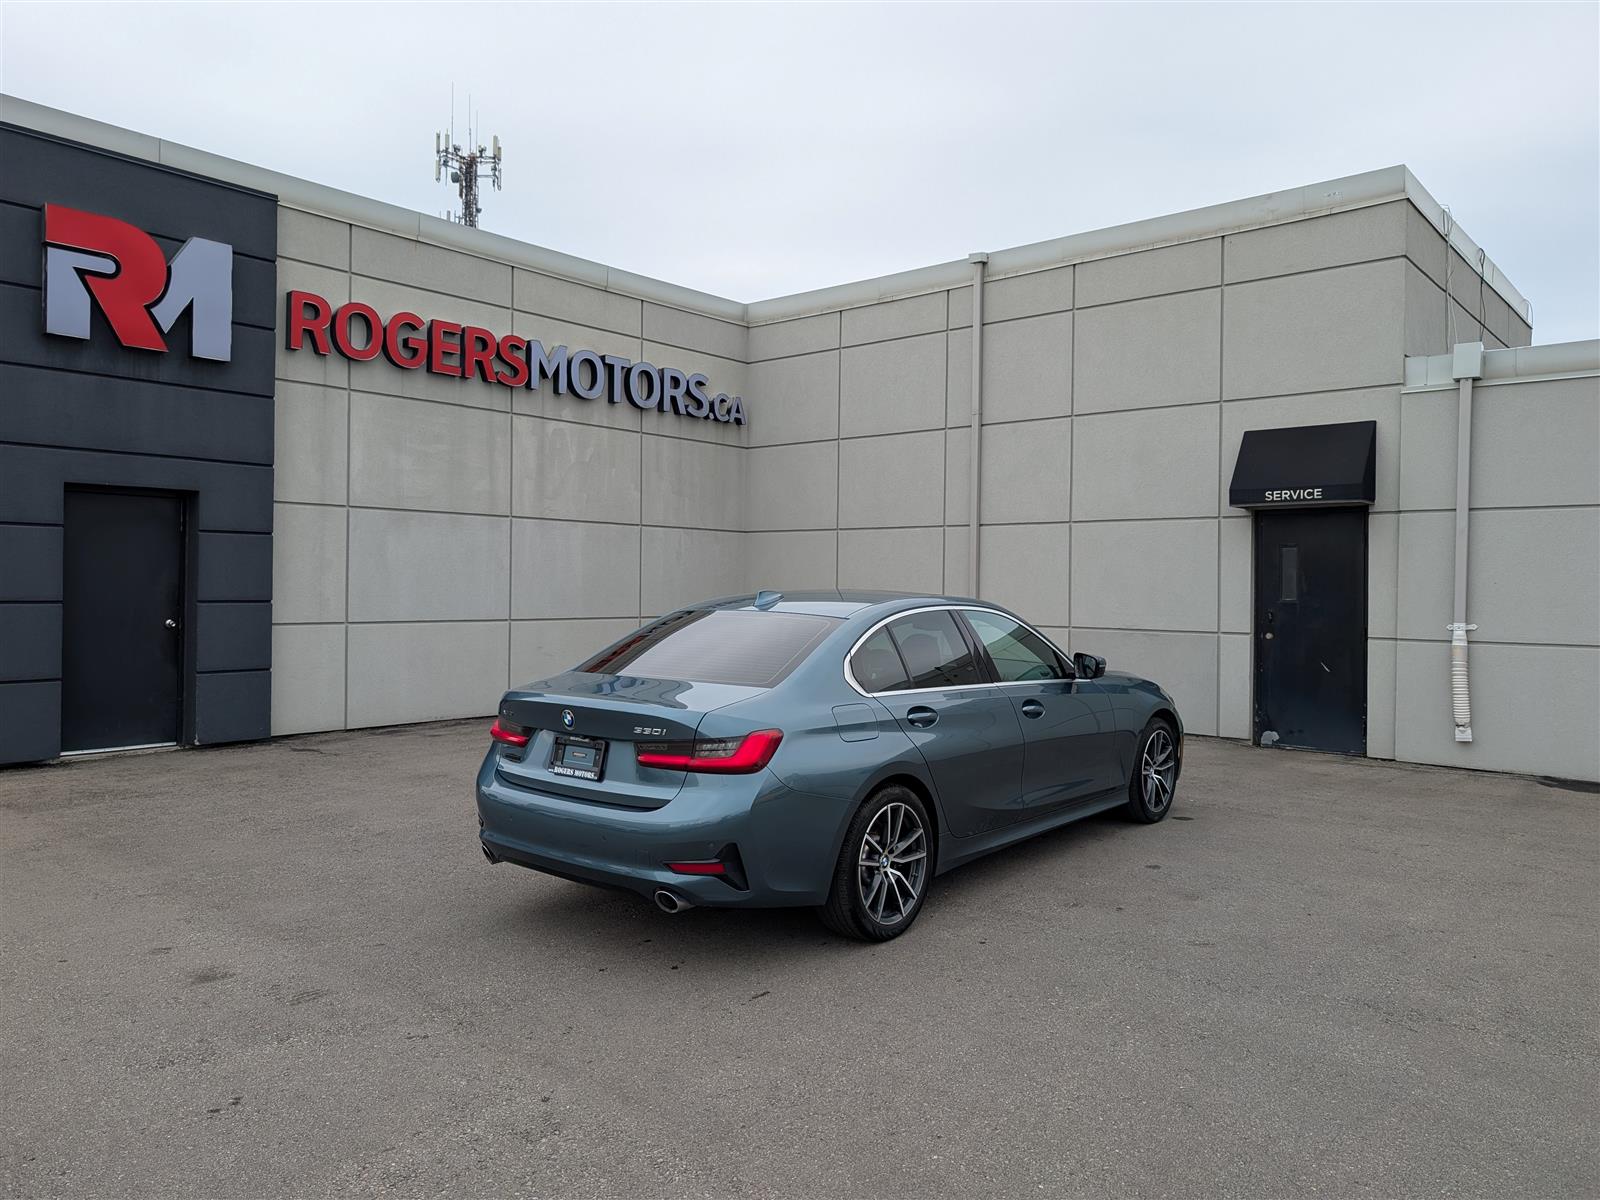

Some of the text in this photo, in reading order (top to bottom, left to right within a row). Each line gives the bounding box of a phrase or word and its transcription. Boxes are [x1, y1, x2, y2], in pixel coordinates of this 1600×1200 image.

[1265, 488, 1323, 501] SERVICE
[553, 766, 595, 779] ROGERS MOTORS
